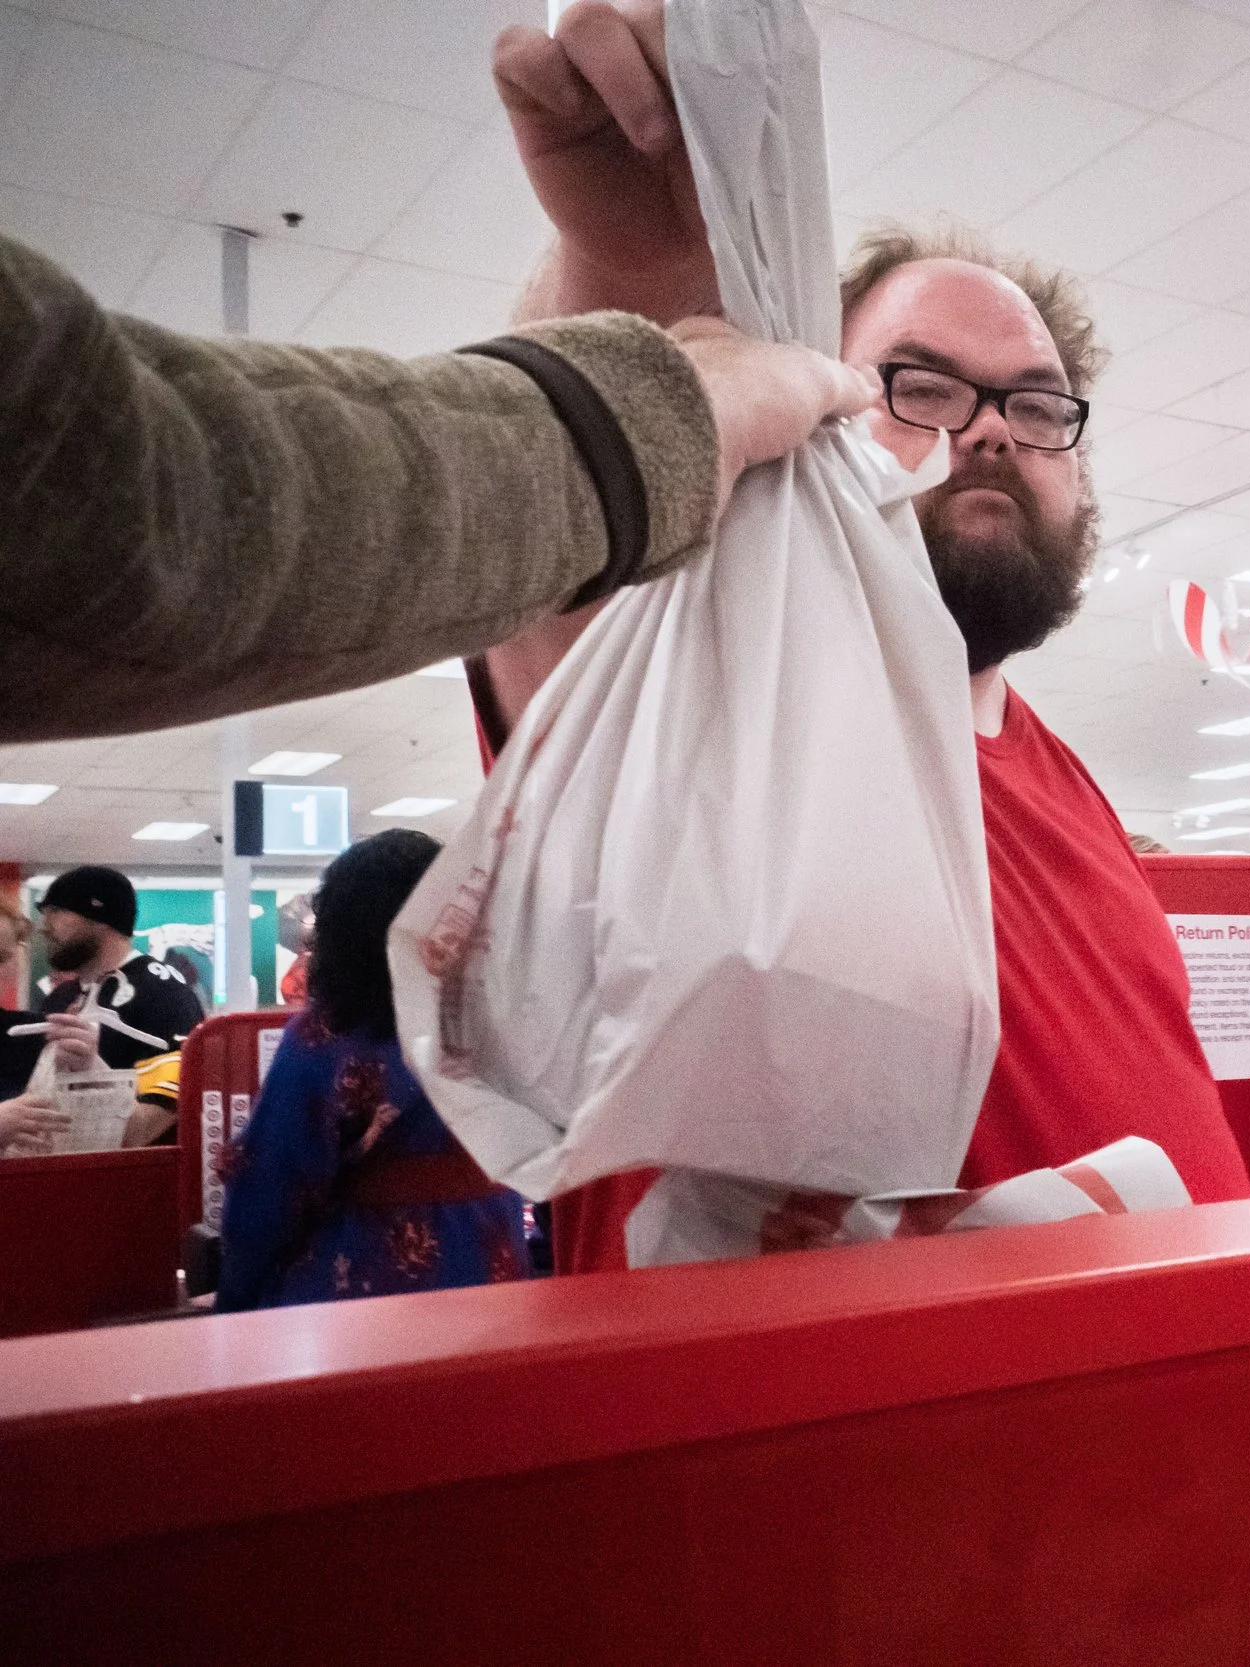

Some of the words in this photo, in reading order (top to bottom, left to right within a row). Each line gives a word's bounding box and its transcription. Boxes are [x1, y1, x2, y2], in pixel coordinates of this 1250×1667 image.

[291, 794, 319, 846] 1
[1175, 925, 1224, 940] Return
[147, 962, 187, 985] 90
